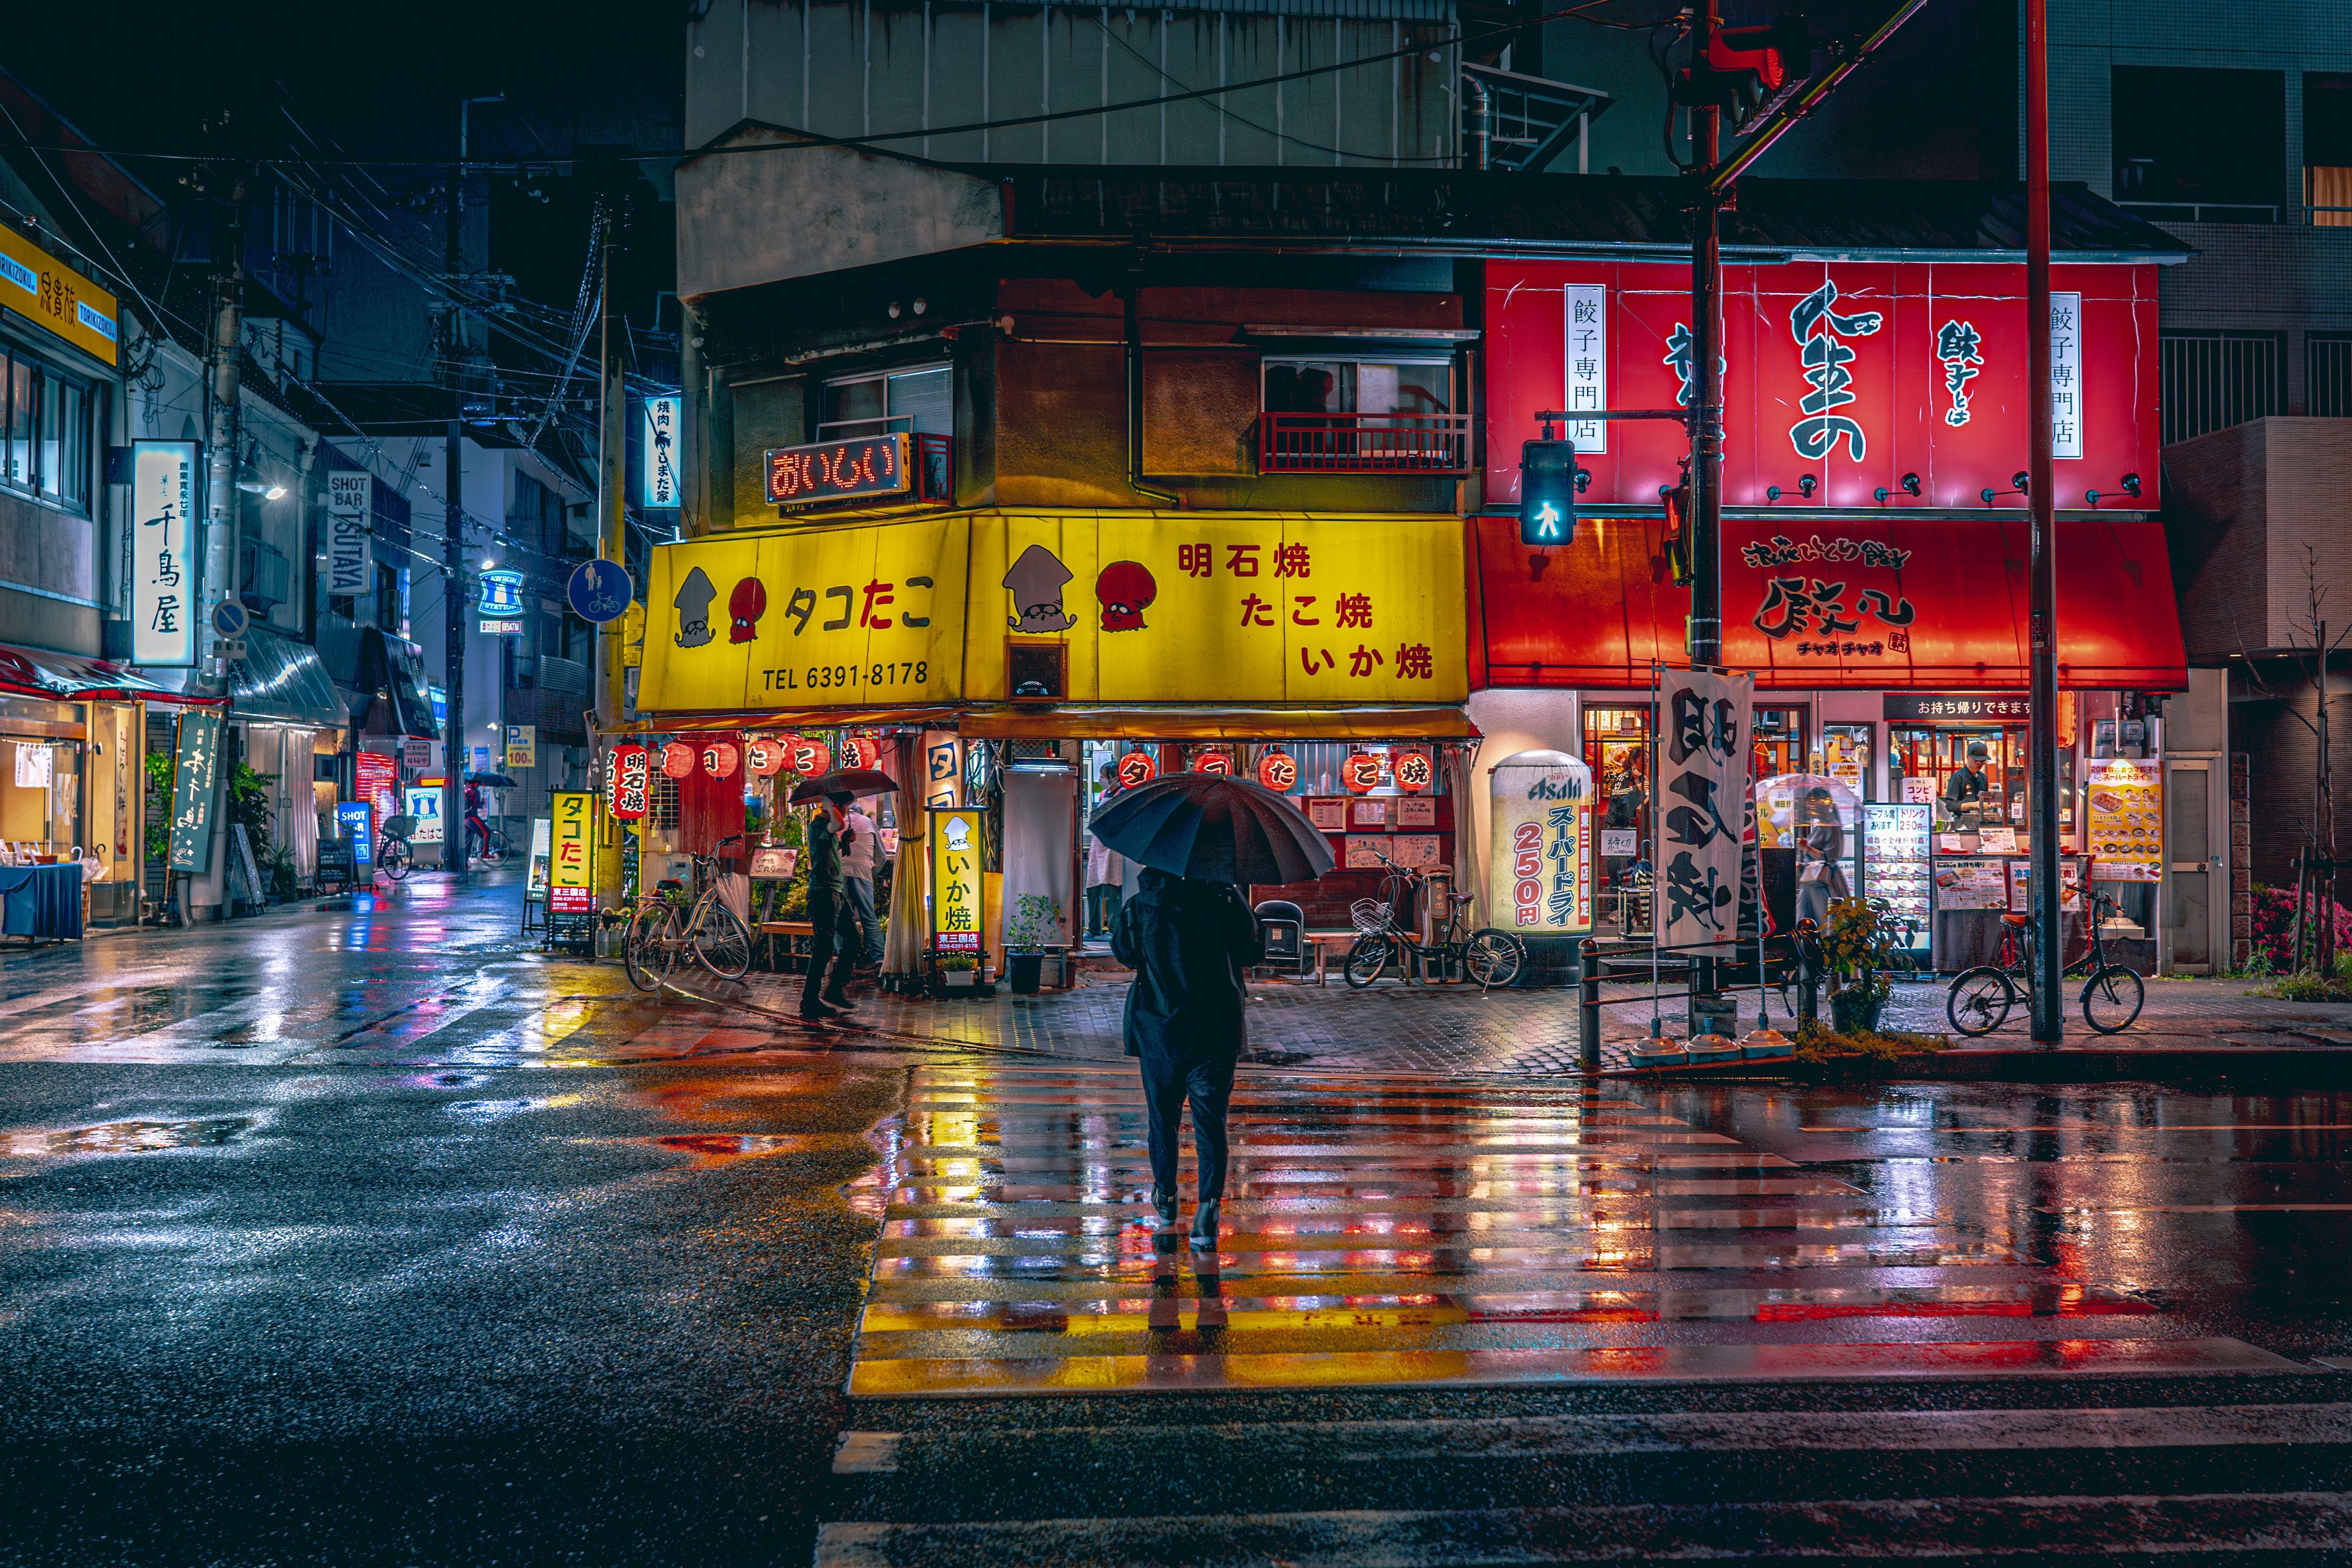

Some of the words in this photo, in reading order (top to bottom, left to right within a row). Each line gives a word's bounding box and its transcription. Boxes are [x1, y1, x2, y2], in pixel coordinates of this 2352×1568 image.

[0, 255, 32, 288] RIKIZOKU
[79, 305, 112, 336] TORIKIZOKU
[1573, 300, 1597, 438] 餃子専門店
[2050, 308, 2073, 444] 餃子専門店
[657, 401, 669, 426] 焼肉
[332, 478, 366, 491] SHOT
[657, 453, 669, 502] しまだ家
[772, 445, 893, 496] おいしい
[179, 462, 188, 518] 創業寛永七年
[335, 493, 363, 506] BAR
[333, 511, 363, 589] TSUTAYA
[1179, 542, 1310, 578] 明石焼
[143, 503, 180, 633] 千鳥屋
[785, 576, 934, 636] タコたこ
[1241, 592, 1373, 628] たこ焼
[215, 643, 245, 651] 自動車
[1301, 643, 1432, 679] いか焼
[1797, 641, 1884, 656] チャオチャオ
[763, 669, 798, 690] TEL
[807, 661, 927, 688] 6391-8178
[509, 727, 520, 744] P
[747, 745, 768, 769] た
[795, 747, 815, 771] こ
[1402, 757, 1430, 785] 焼
[620, 752, 647, 811] 明石焼
[1122, 760, 1149, 785] タ
[1270, 762, 1295, 785] た
[1354, 762, 1378, 786] こ
[1528, 776, 1581, 801] Asahi
[1908, 786, 1931, 794] コンビ
[342, 810, 367, 820] SHOT
[1871, 821, 1892, 830] あります
[1902, 809, 1925, 818] ドリンク
[561, 797, 583, 885] タコたこ
[1607, 837, 1631, 851] 締切
[1514, 821, 1543, 926] 250円
[1547, 805, 1576, 927] スーパードライ
[1580, 812, 1589, 917] 東三国店限定
[553, 888, 587, 897] 東三国店
[945, 855, 971, 931] いか焼
[939, 934, 978, 943] 東三国店
